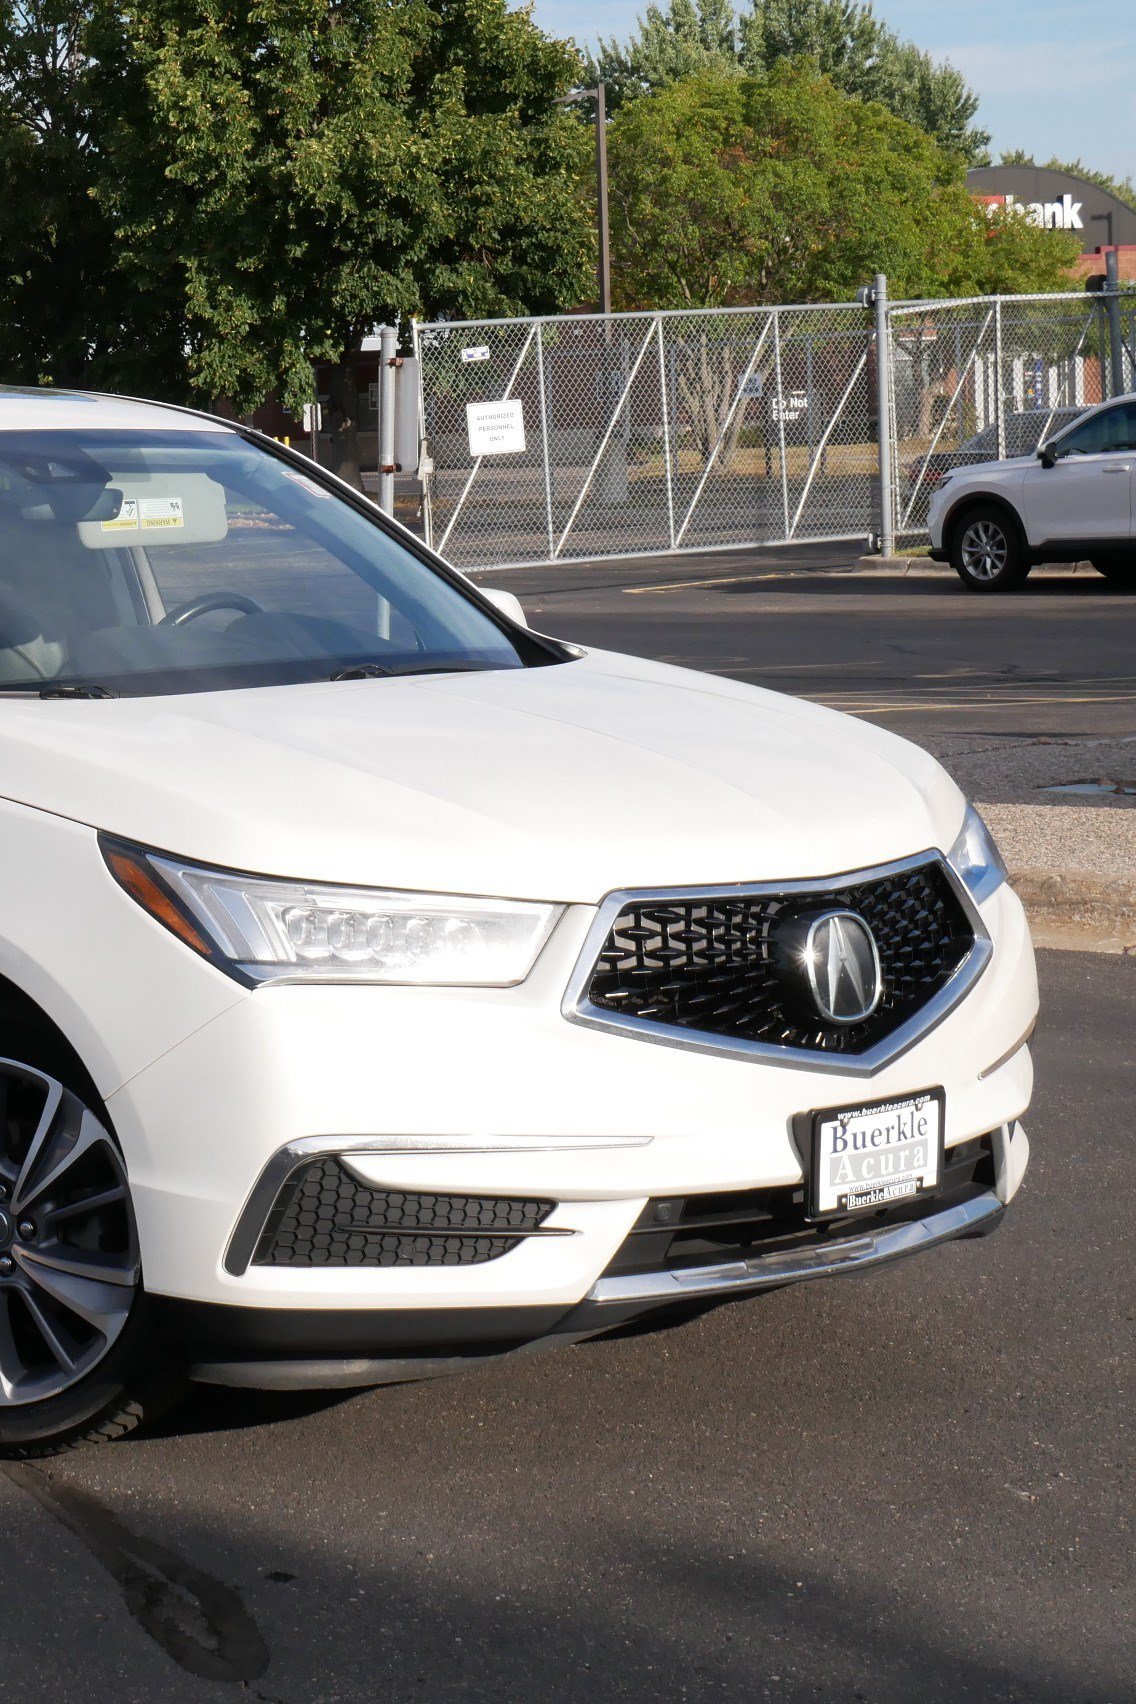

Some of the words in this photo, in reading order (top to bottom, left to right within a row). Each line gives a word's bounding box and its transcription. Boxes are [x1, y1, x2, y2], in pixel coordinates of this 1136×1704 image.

[790, 397, 808, 408] Not
[476, 413, 514, 421] AUTHORIZED
[837, 1095, 931, 1120] www.buerkleacura.com
[830, 1110, 928, 1154] Buerkle
[833, 1145, 925, 1183] Acura
